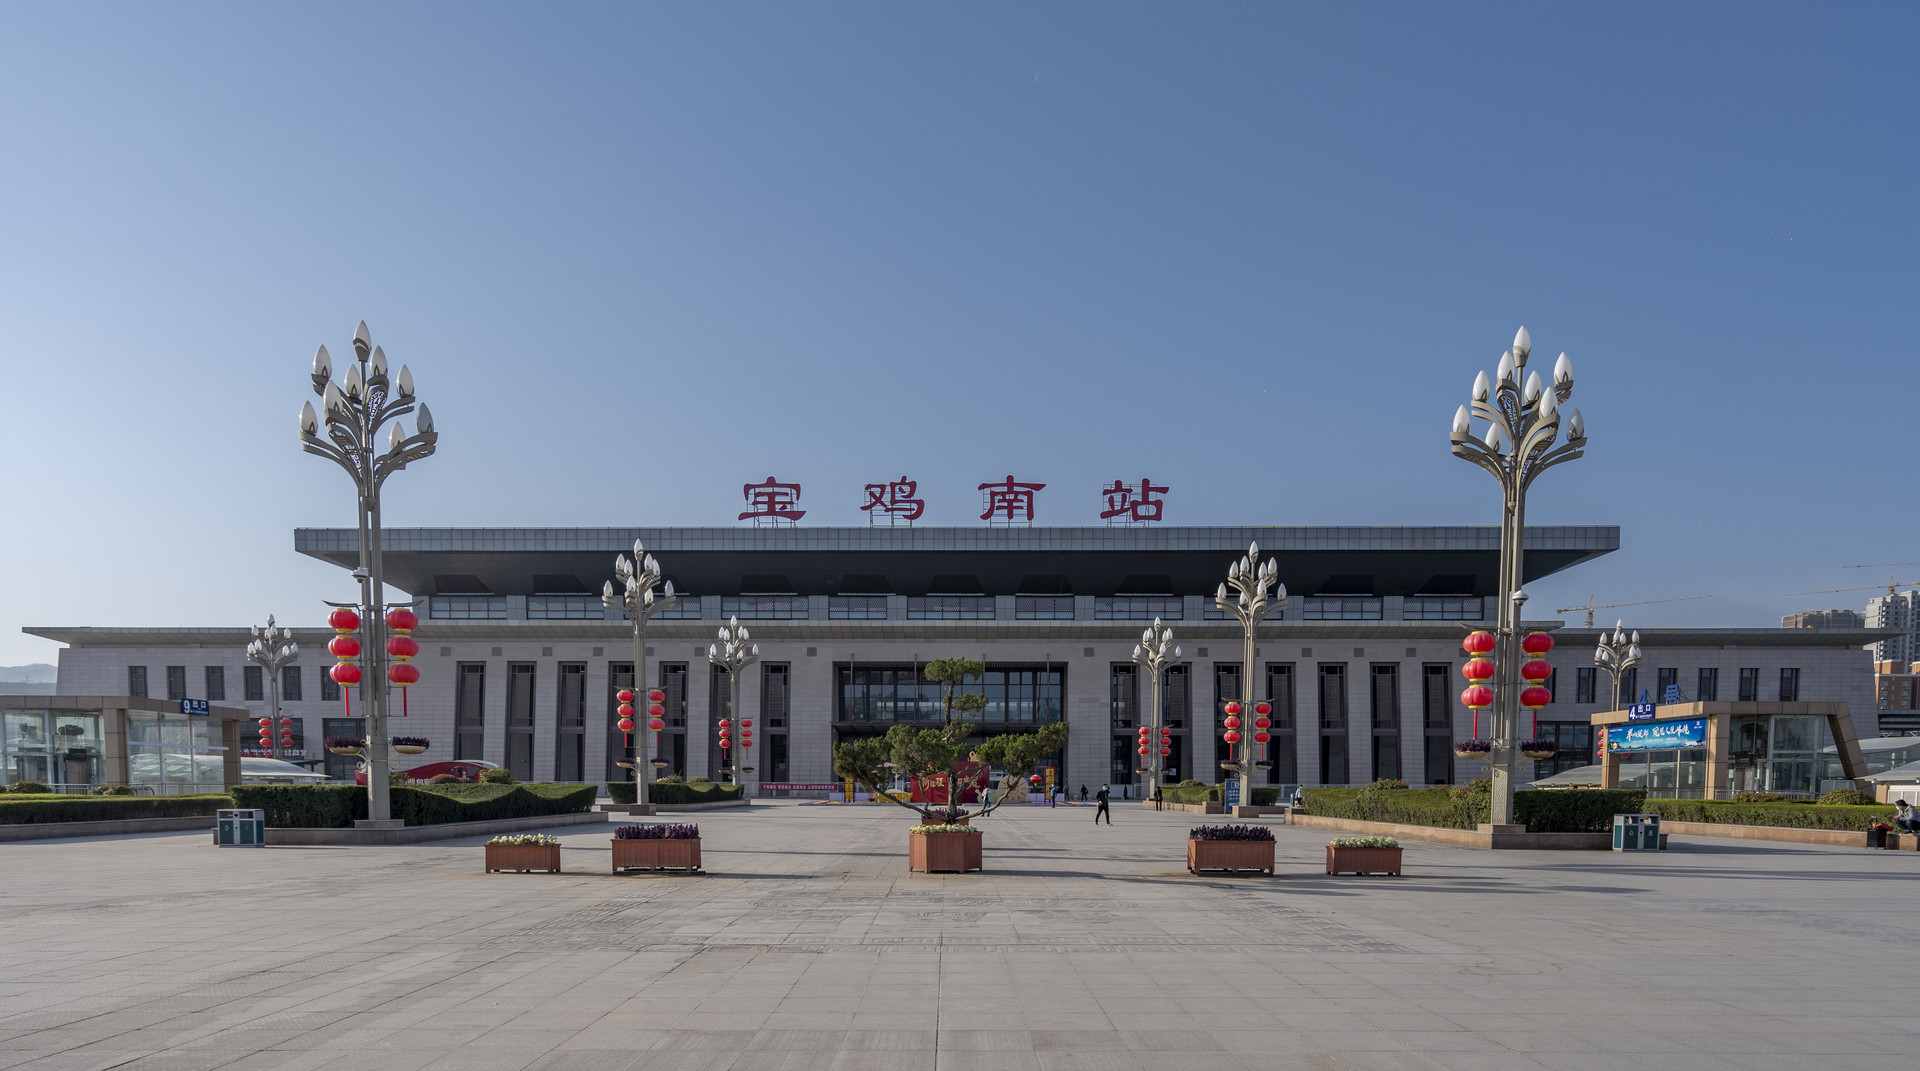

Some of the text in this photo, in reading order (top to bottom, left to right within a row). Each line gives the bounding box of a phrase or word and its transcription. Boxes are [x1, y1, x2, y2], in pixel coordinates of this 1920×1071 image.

[738, 476, 1170, 521] 宝鸡南站
[183, 699, 191, 714] 9
[192, 699, 206, 709] 出口
[1629, 706, 1636, 720] 4
[1637, 704, 1651, 713] 出口
